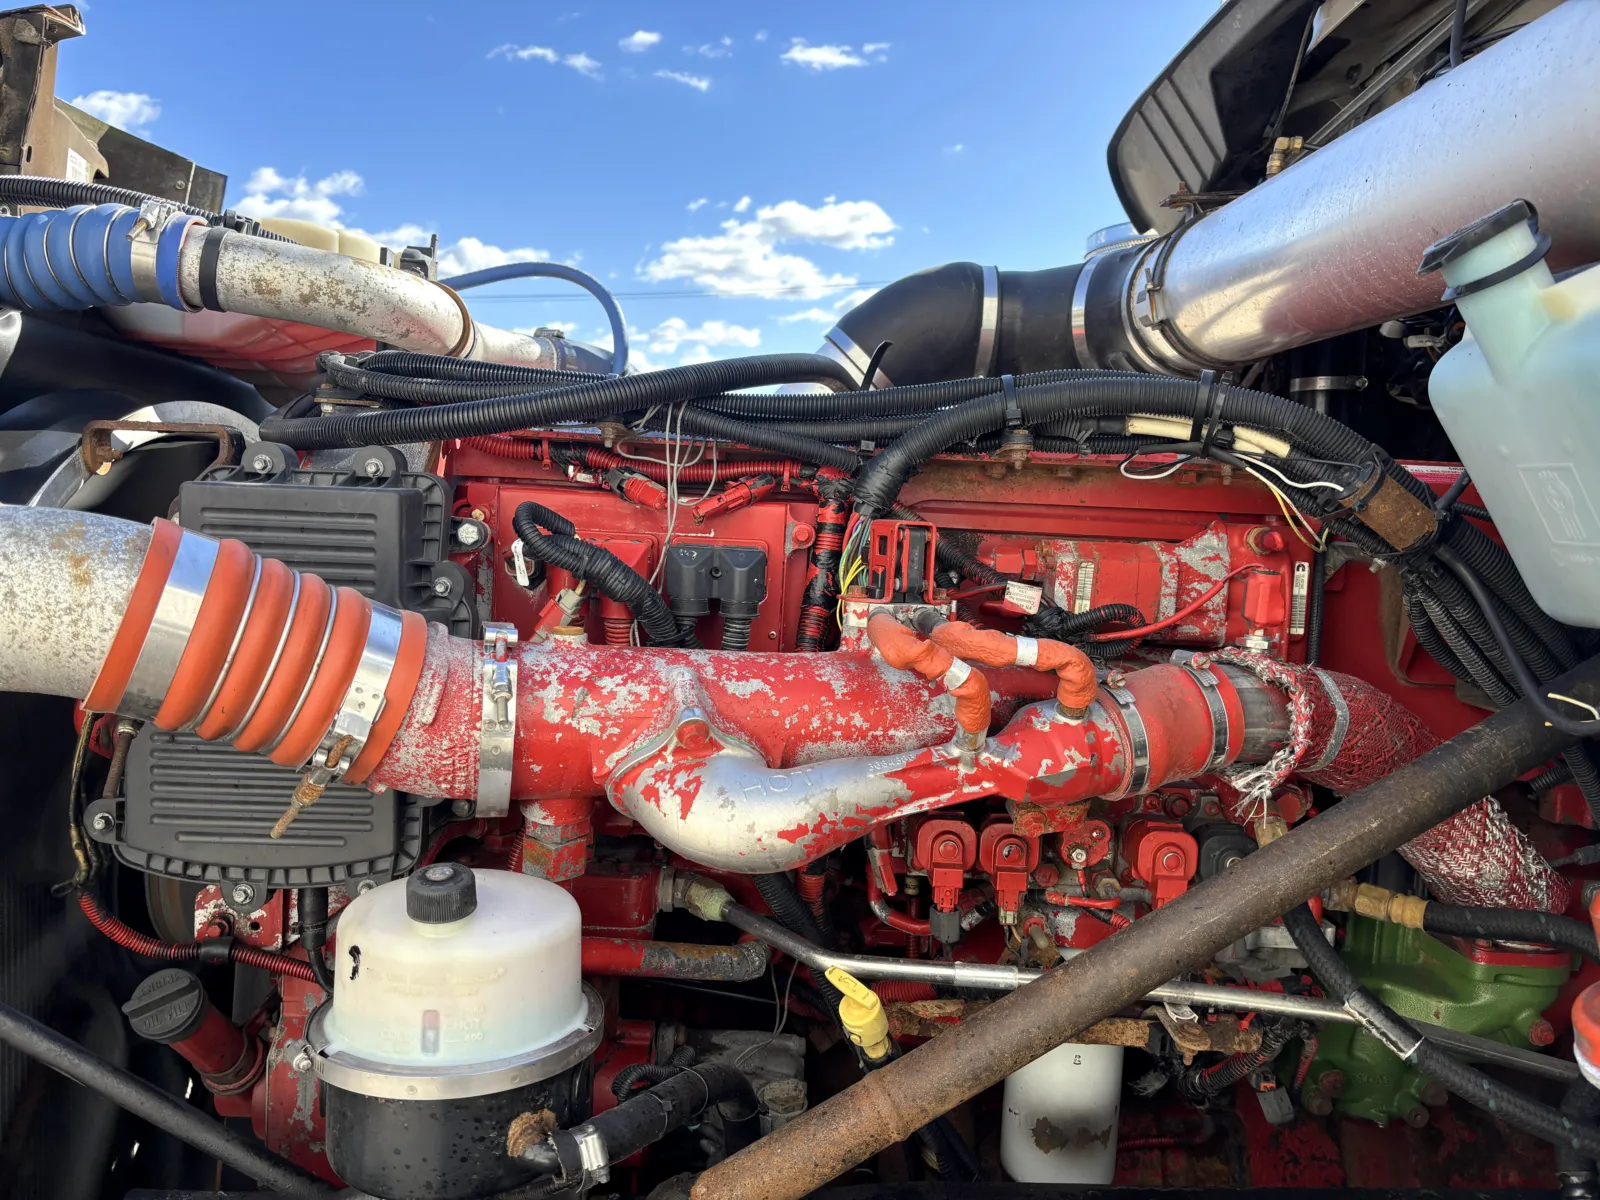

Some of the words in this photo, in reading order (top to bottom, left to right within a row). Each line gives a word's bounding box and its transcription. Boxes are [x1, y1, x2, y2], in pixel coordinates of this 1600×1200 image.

[735, 768, 813, 802] HOT
[141, 971, 181, 996] ENGINE
[143, 1013, 163, 1031] OIL
[167, 1001, 190, 1021] FILL
